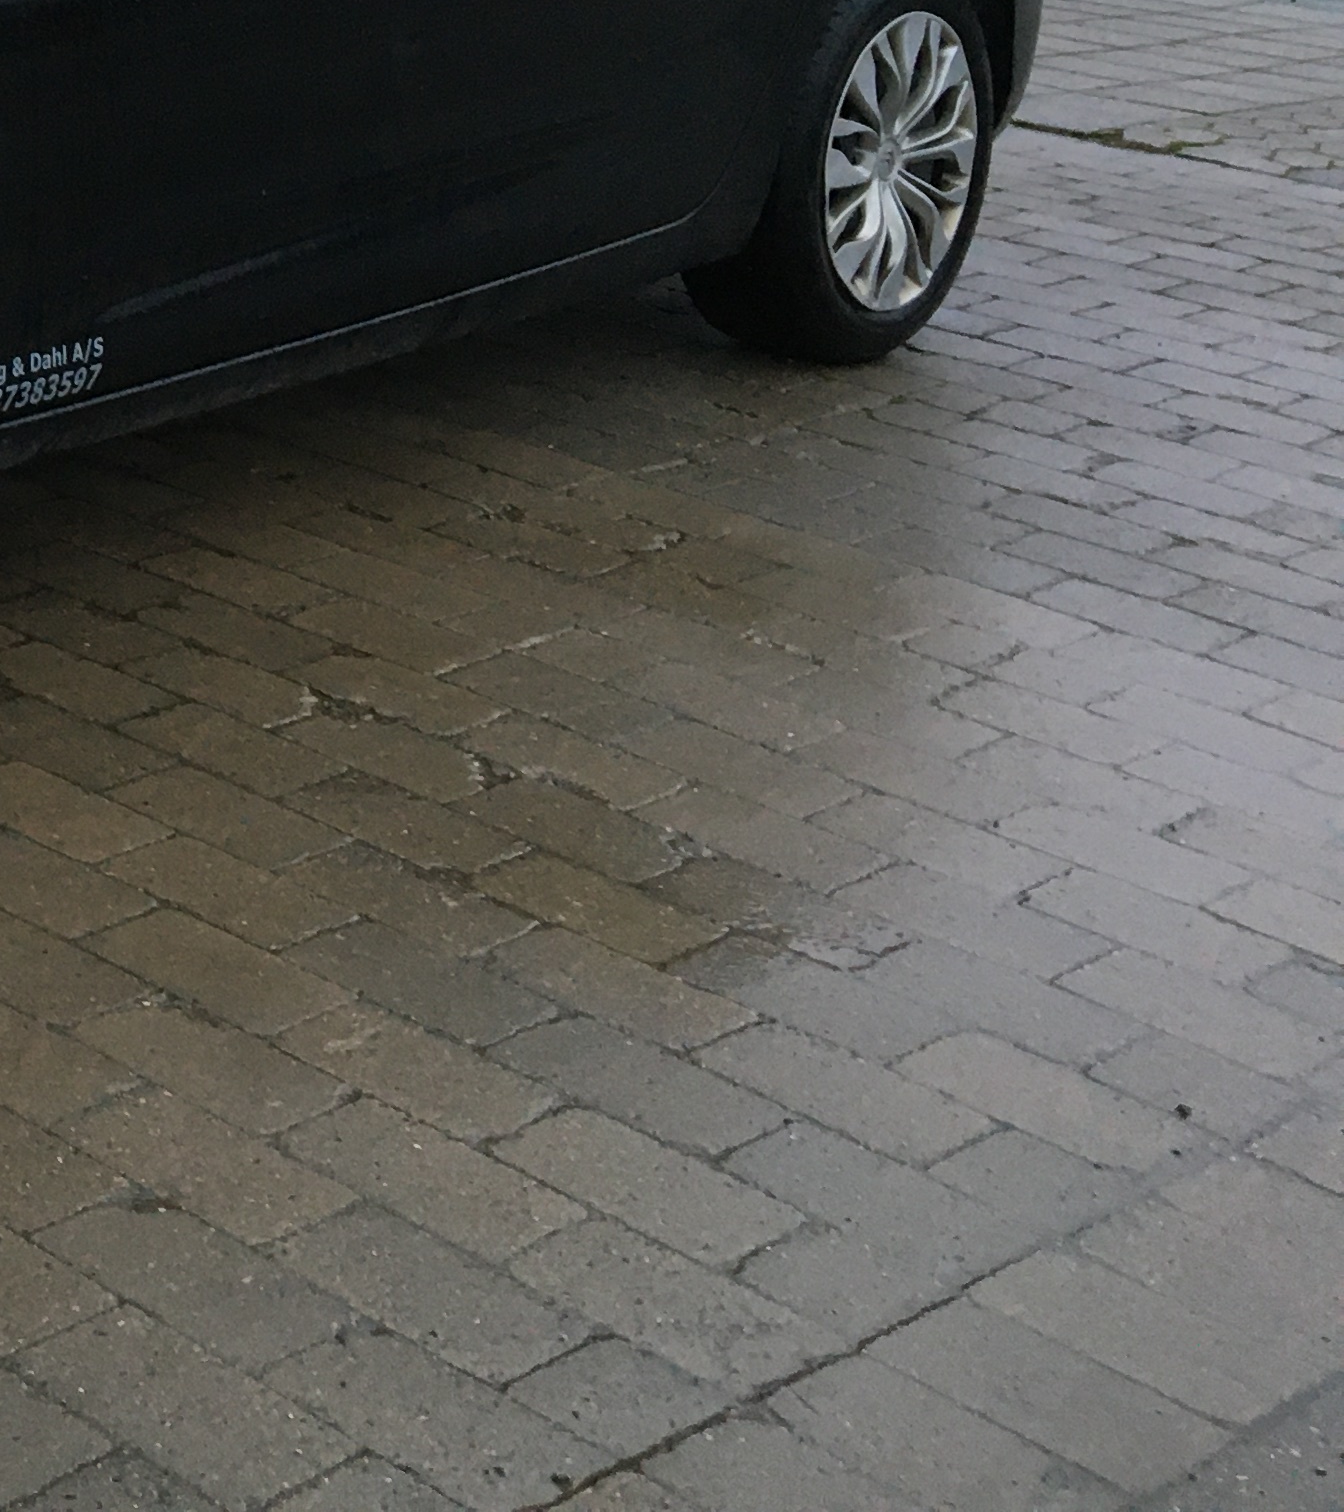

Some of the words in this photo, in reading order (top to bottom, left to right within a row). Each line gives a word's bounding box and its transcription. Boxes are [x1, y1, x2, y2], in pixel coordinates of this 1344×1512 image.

[12, 356, 26, 377] &
[30, 344, 67, 373] Dahl
[72, 336, 104, 363] A/S
